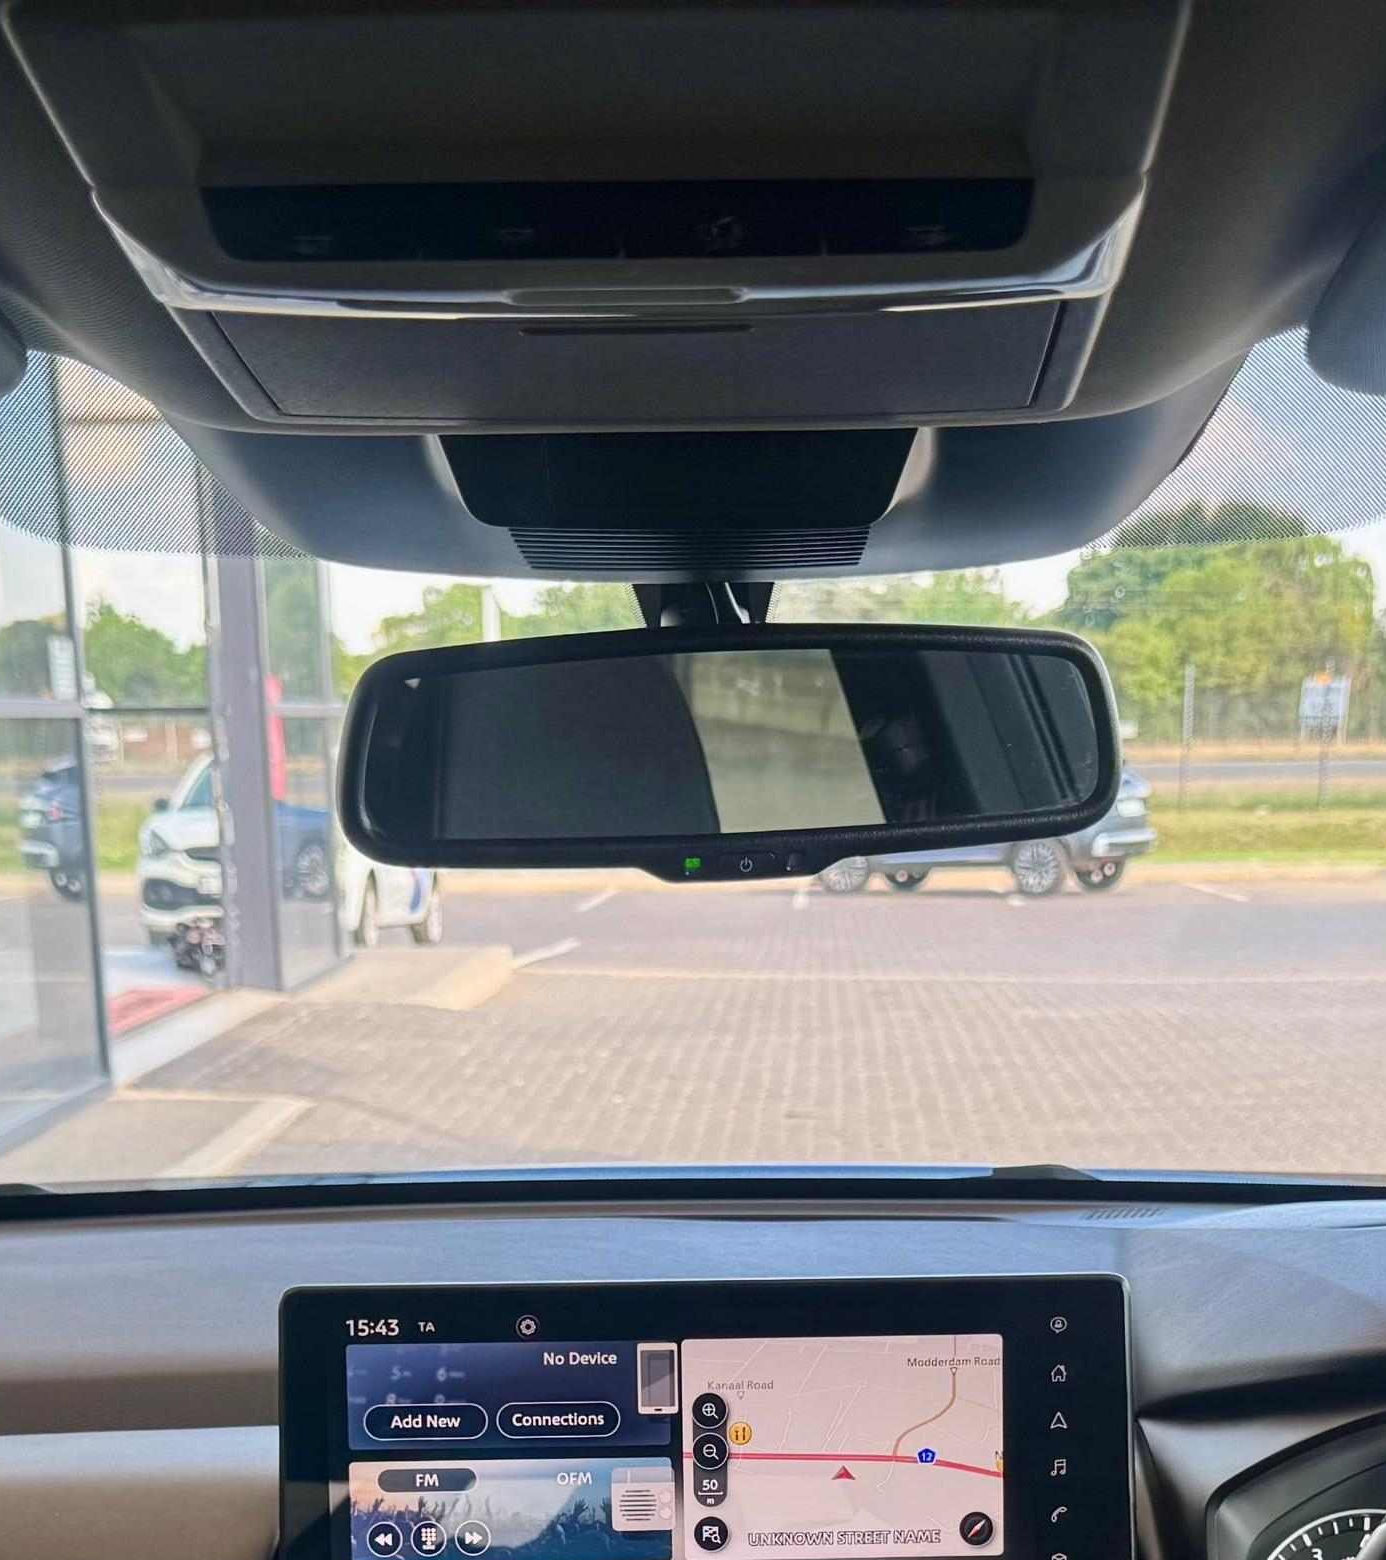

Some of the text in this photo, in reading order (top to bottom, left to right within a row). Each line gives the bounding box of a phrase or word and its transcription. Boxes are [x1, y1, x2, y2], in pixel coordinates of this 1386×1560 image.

[345, 1319, 400, 1337] 15:43
[418, 1321, 436, 1333] TA
[542, 1351, 618, 1366] No Device
[906, 1356, 1001, 1368] Modderdam Road
[707, 1379, 775, 1391] Kanaal Road
[389, 1414, 461, 1429] Add New
[511, 1412, 605, 1428] Connections
[415, 1473, 440, 1488] FM
[556, 1471, 593, 1486] OFM
[701, 1479, 719, 1492] 50
[747, 1528, 942, 1547] UNKNOWN STREET NAME
